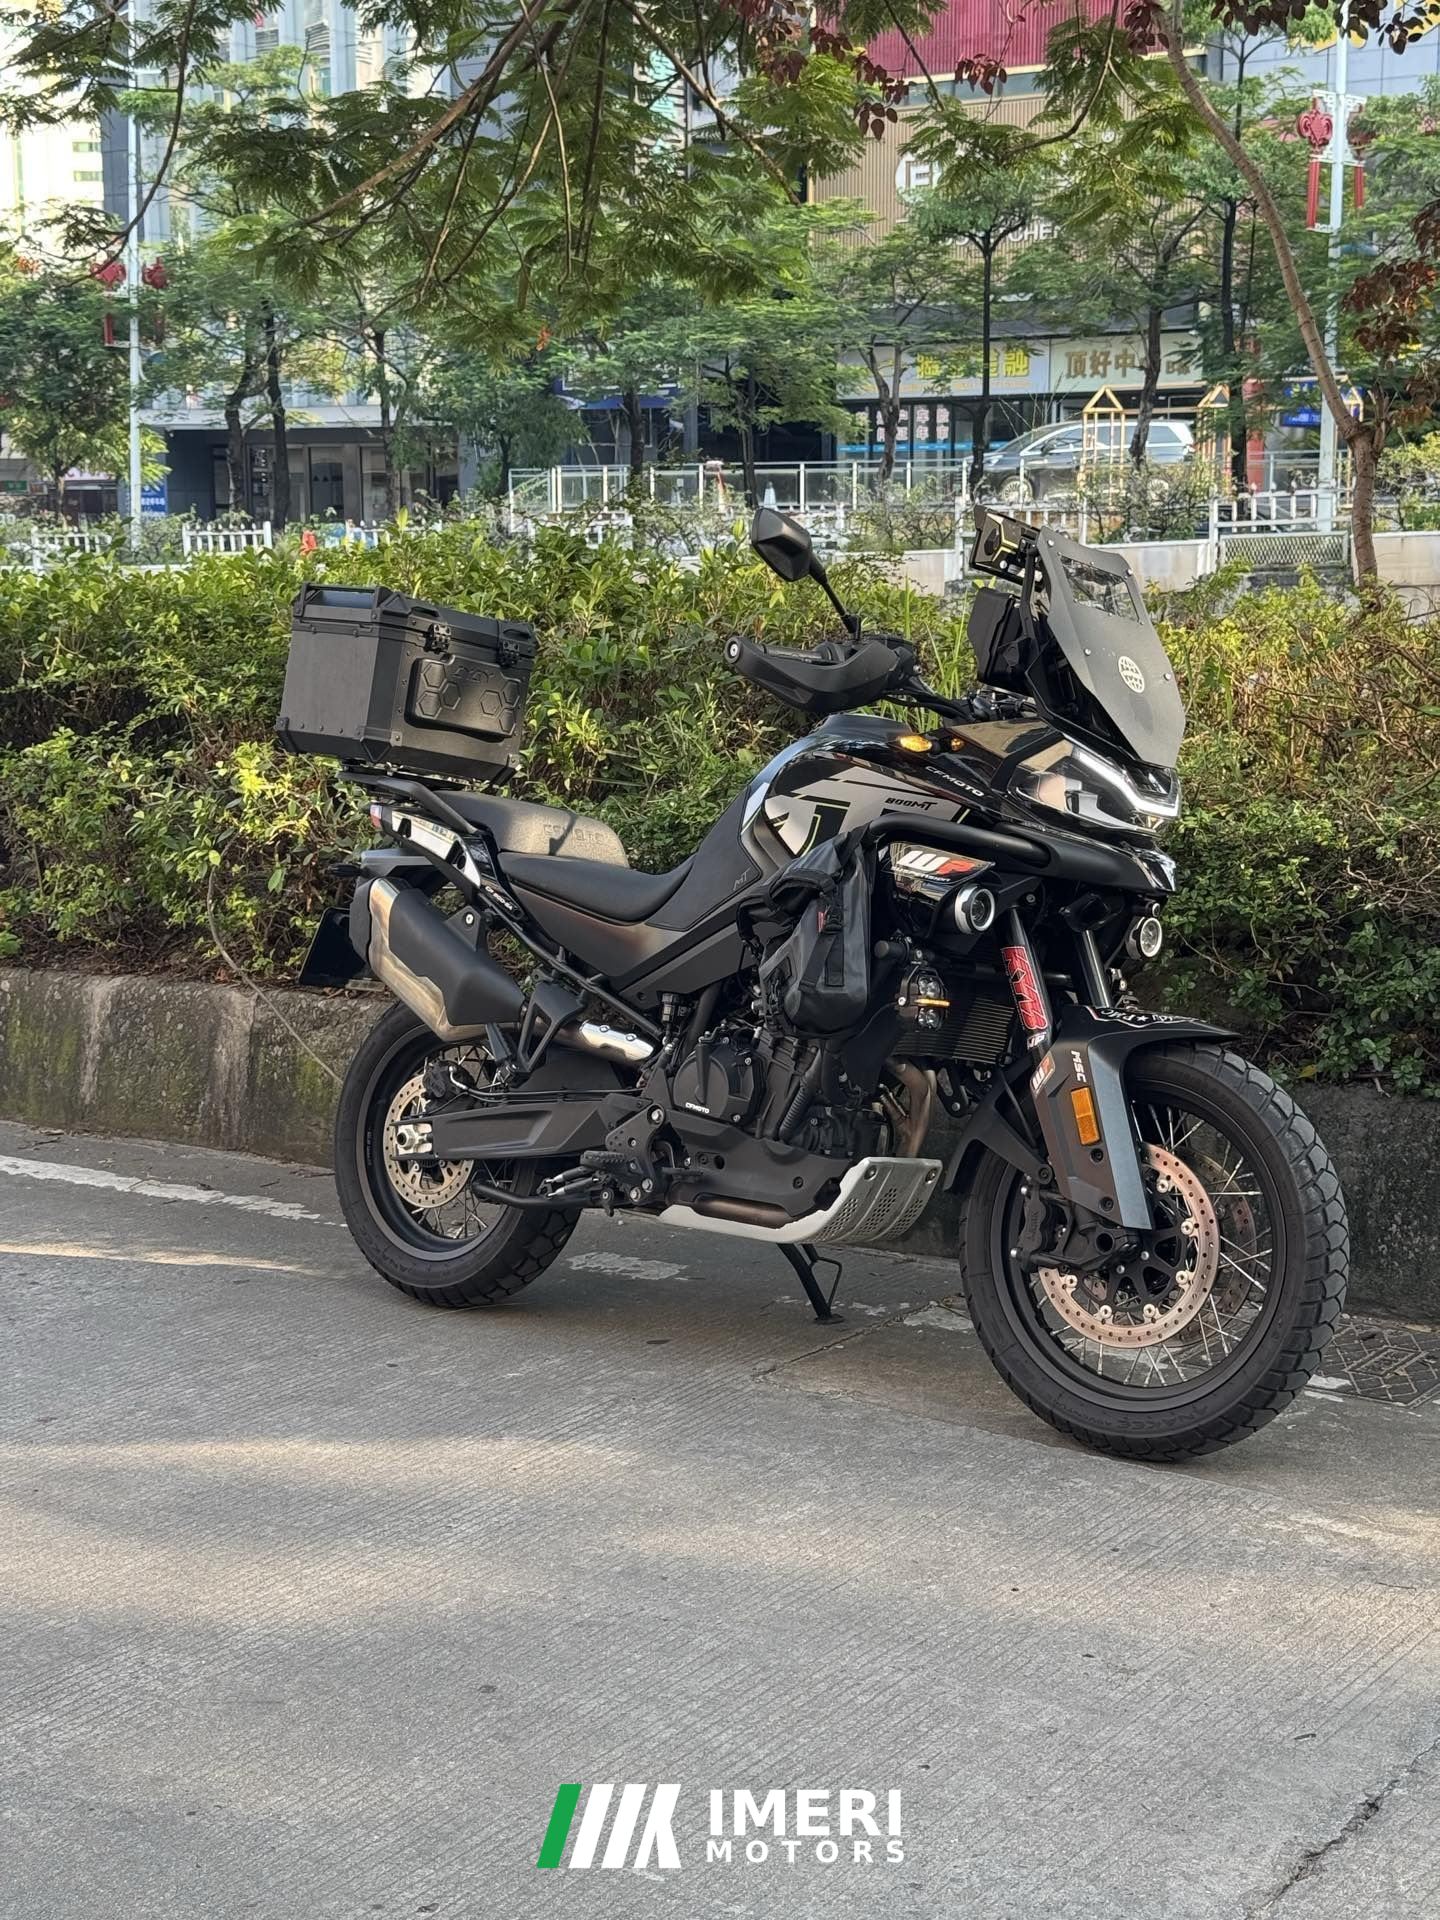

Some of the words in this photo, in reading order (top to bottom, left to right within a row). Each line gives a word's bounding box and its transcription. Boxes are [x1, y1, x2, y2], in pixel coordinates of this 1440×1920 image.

[924, 765, 985, 798] CFMOTO
[885, 797, 938, 811] 800MT
[896, 850, 977, 876] WP
[1000, 946, 1048, 1031] KYB
[1070, 1050, 1088, 1084] MSC
[685, 1101, 710, 1114] CFMOTO
